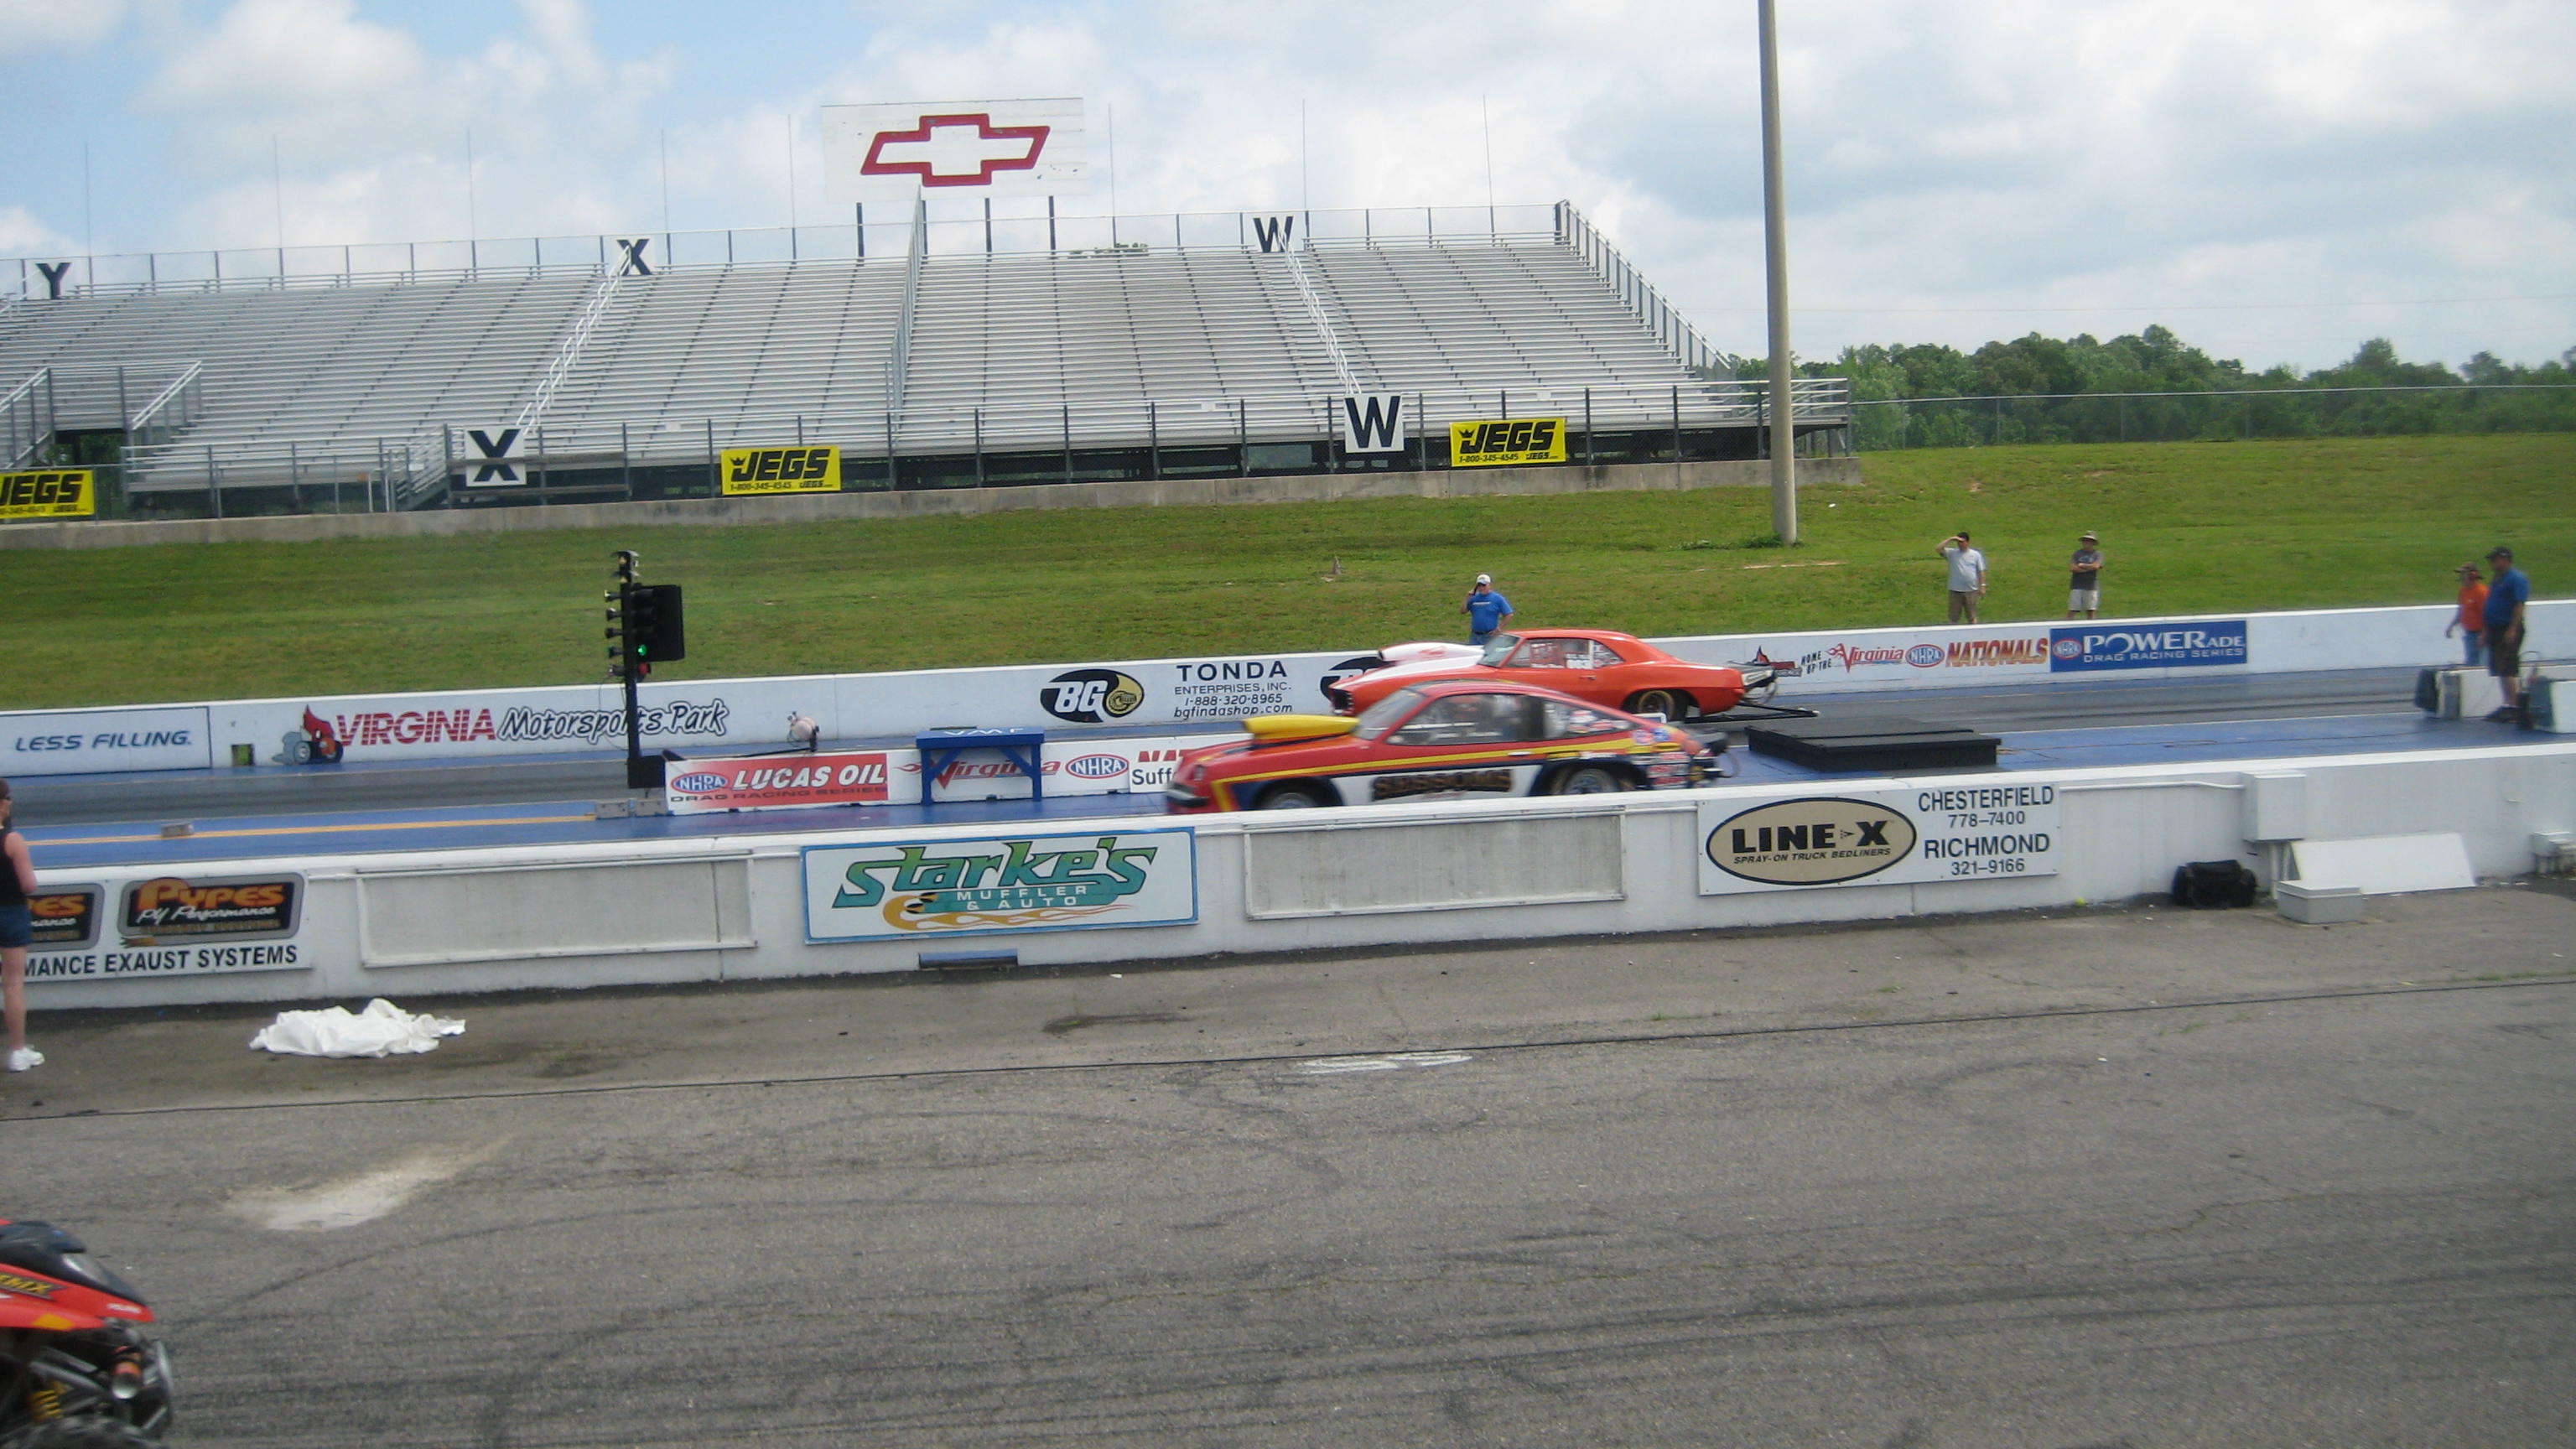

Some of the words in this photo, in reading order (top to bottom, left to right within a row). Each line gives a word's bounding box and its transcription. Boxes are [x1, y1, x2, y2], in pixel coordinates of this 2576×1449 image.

[1253, 216, 1294, 252] W
[616, 239, 652, 275] X
[35, 262, 71, 299] Y
[1345, 396, 1400, 448] W
[1460, 421, 1556, 454] JEGS
[467, 428, 521, 482] X
[731, 449, 831, 481] JEGS
[1838, 643, 1903, 672] Virginia
[1910, 648, 1942, 664] NHRA
[1945, 637, 2049, 667] NATIONALS
[2084, 653, 2124, 663] DRAG
[2131, 651, 2185, 661] RACING
[2191, 647, 2244, 658] SERIES
[1176, 661, 1288, 682] TONDA
[1051, 679, 1109, 715] BG
[1175, 683, 1265, 695] ENTERPRISES,
[1267, 682, 1292, 692] INC.
[337, 709, 496, 746] VIRGINIA
[670, 699, 728, 735] Park
[1174, 704, 1292, 719] bgfindashop.com
[16, 735, 82, 751] LESS
[92, 730, 192, 749] FILLING.
[678, 775, 723, 791] NHRA
[732, 766, 832, 792] LUCAS
[839, 764, 886, 786] OIL
[1075, 758, 1124, 776] NHRA
[671, 793, 727, 802] DRAG
[734, 789, 810, 799] RACING
[815, 785, 888, 797] SERIES
[1919, 786, 2054, 812] CHESTERFIELD
[1948, 810, 2025, 828] 778-7400
[1734, 852, 1788, 865] SPRAY-ON
[1793, 850, 1827, 861] TRUCK
[1831, 848, 1891, 859] BEDLINERS
[1924, 833, 2049, 860] RICHMOND
[1951, 858, 2025, 876] 321-9166
[957, 886, 1088, 901] MUFFLER
[967, 901, 980, 911] &
[998, 896, 1077, 910] AUTO
[105, 951, 190, 973] EXAUST
[198, 945, 297, 967] SYSTEMS
